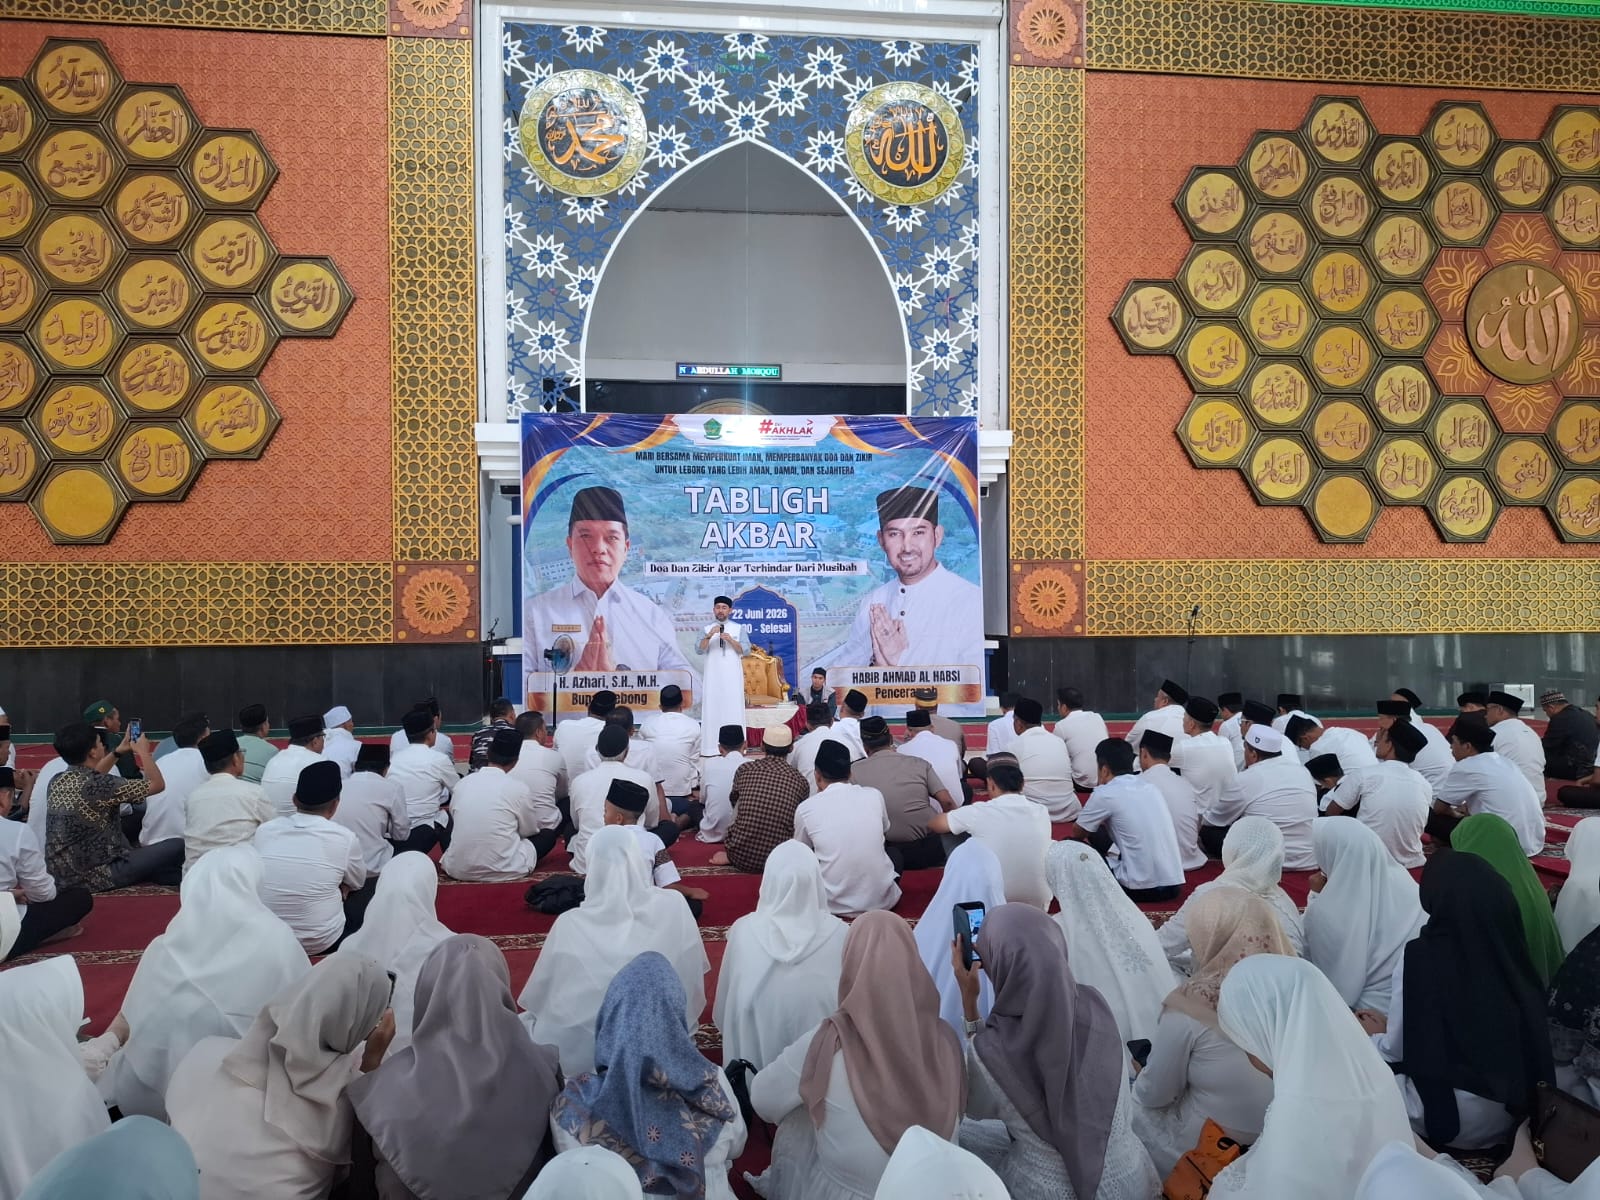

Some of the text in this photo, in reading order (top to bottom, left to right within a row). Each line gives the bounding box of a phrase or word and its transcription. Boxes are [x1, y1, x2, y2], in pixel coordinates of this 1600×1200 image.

[551, 113, 625, 165] محمد
[1477, 269, 1571, 371] الله
[636, 451, 654, 460] MARI
[656, 452, 691, 461] BERSAMA
[693, 452, 740, 461] MEMPERKUAT
[766, 453, 822, 462] MEMPERBANYAK
[824, 453, 838, 461] DOA
[840, 453, 853, 461] DAN
[856, 453, 872, 461] ZIKIR
[655, 465, 677, 474] UNTUK
[680, 466, 705, 474] LEBONG
[708, 466, 725, 474] YANG
[728, 466, 747, 474] LEBIH
[801, 466, 814, 475] DAN
[817, 466, 854, 475] SEJAHTERA
[684, 487, 828, 514] TABLIGH
[701, 522, 816, 548] AKBAR
[650, 563, 857, 575] Doa Dan Zikir Agar Terhindar Dari Musibah
[732, 608, 787, 619] 22 Juni 2026
[760, 623, 791, 634] Selesai
[559, 677, 569, 688] H.
[573, 675, 608, 690] Azhari,
[637, 675, 660, 687] M.H.
[852, 670, 960, 684] HABIB AHMAD AL HABSI
[616, 693, 648, 706] ebong
